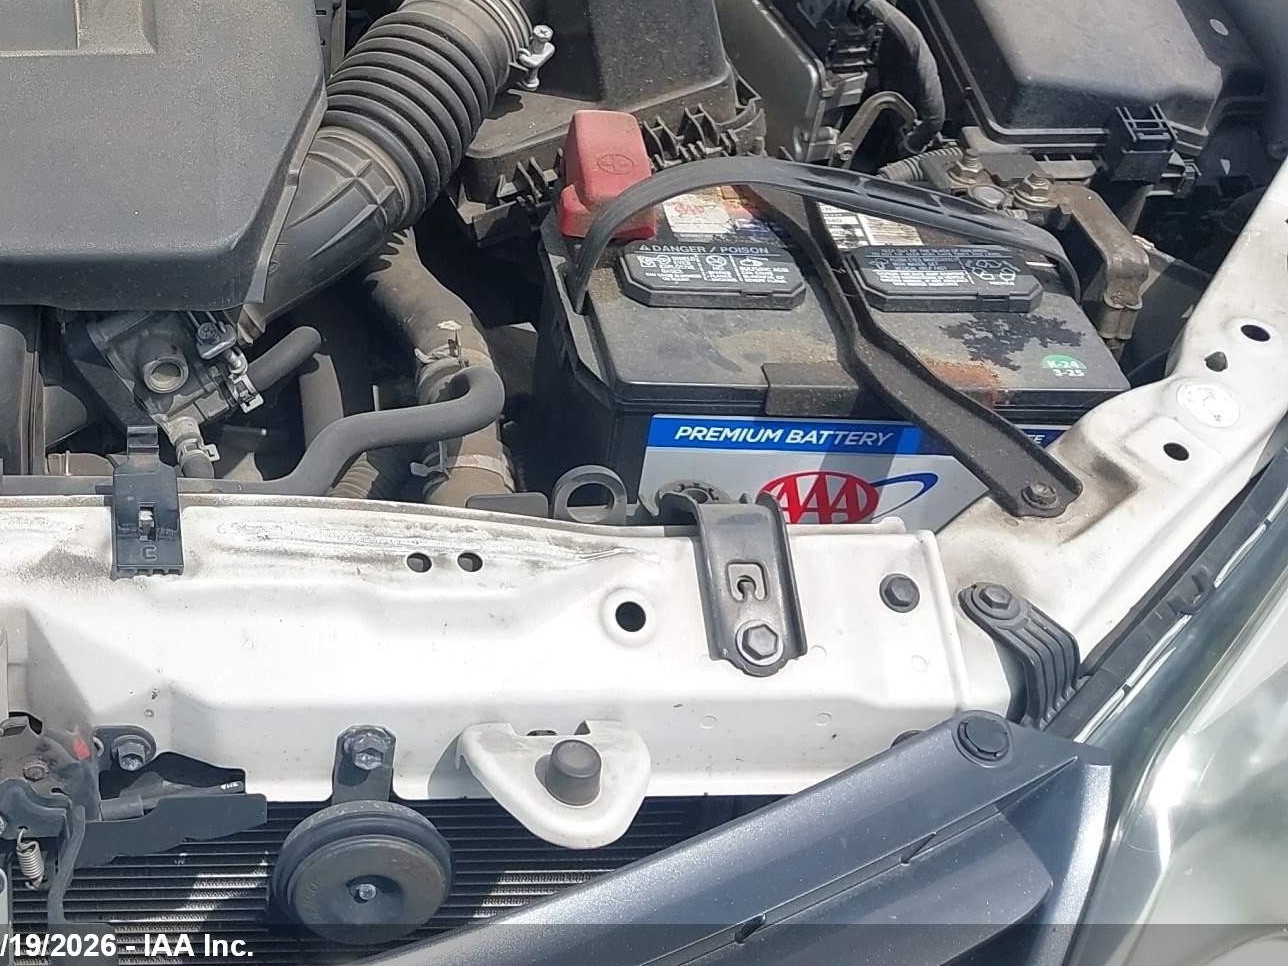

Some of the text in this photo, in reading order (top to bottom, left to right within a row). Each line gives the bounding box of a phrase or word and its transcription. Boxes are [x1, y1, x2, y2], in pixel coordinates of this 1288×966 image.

[652, 245, 706, 253] DANGER
[674, 425, 894, 447] PREMIUM BATTERY
[765, 471, 868, 524] AAA
